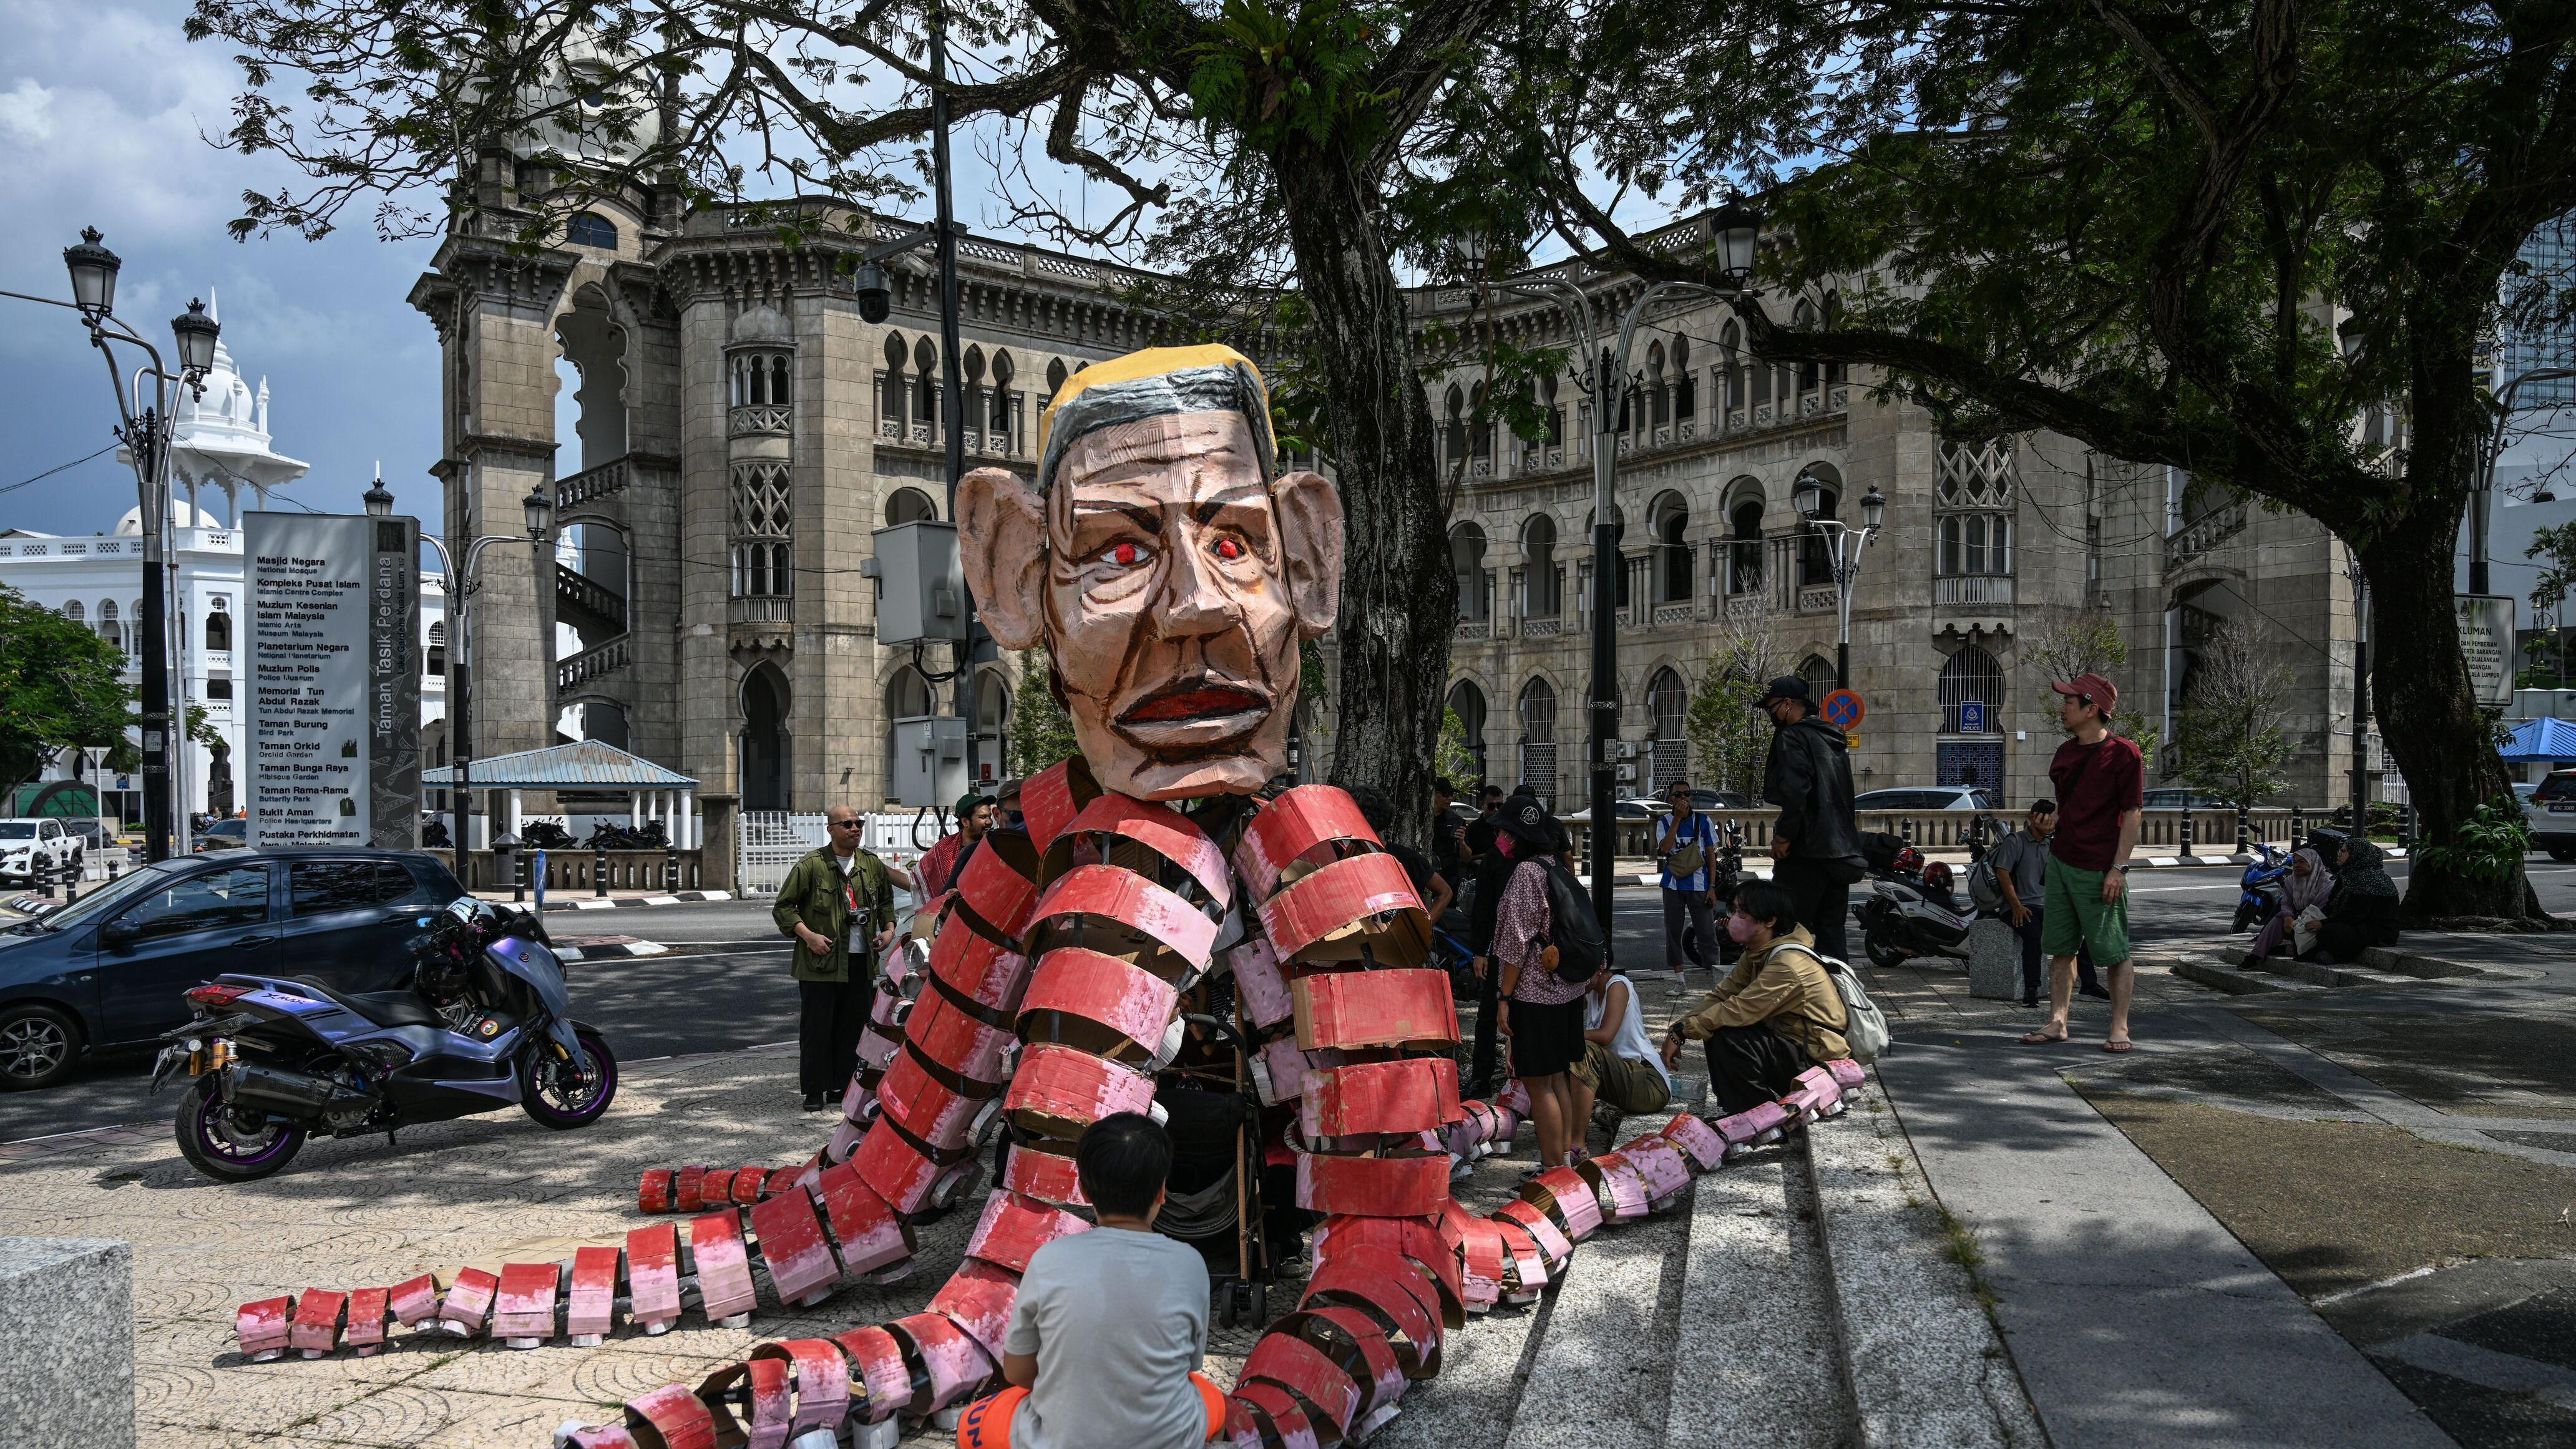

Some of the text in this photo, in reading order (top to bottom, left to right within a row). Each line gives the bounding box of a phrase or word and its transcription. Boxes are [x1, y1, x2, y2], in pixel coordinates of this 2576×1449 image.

[257, 557, 325, 567] Masjid Negara
[289, 567, 318, 575] Mosque
[257, 578, 360, 588] Kompleks Pusat Islam
[312, 589, 343, 597] Complex
[257, 600, 338, 610] Muzium Kesenian
[257, 611, 324, 621] Islam Malaysia
[397, 617, 405, 653] Gardens
[2458, 627, 2492, 635] KLUMAN
[258, 642, 349, 653] Planetarium Negara
[376, 557, 392, 738] Taman Tasik Perdana
[258, 687, 300, 695] Memorial
[294, 720, 328, 729] Burung
[293, 764, 323, 773] Bunga
[326, 764, 348, 773] Raya
